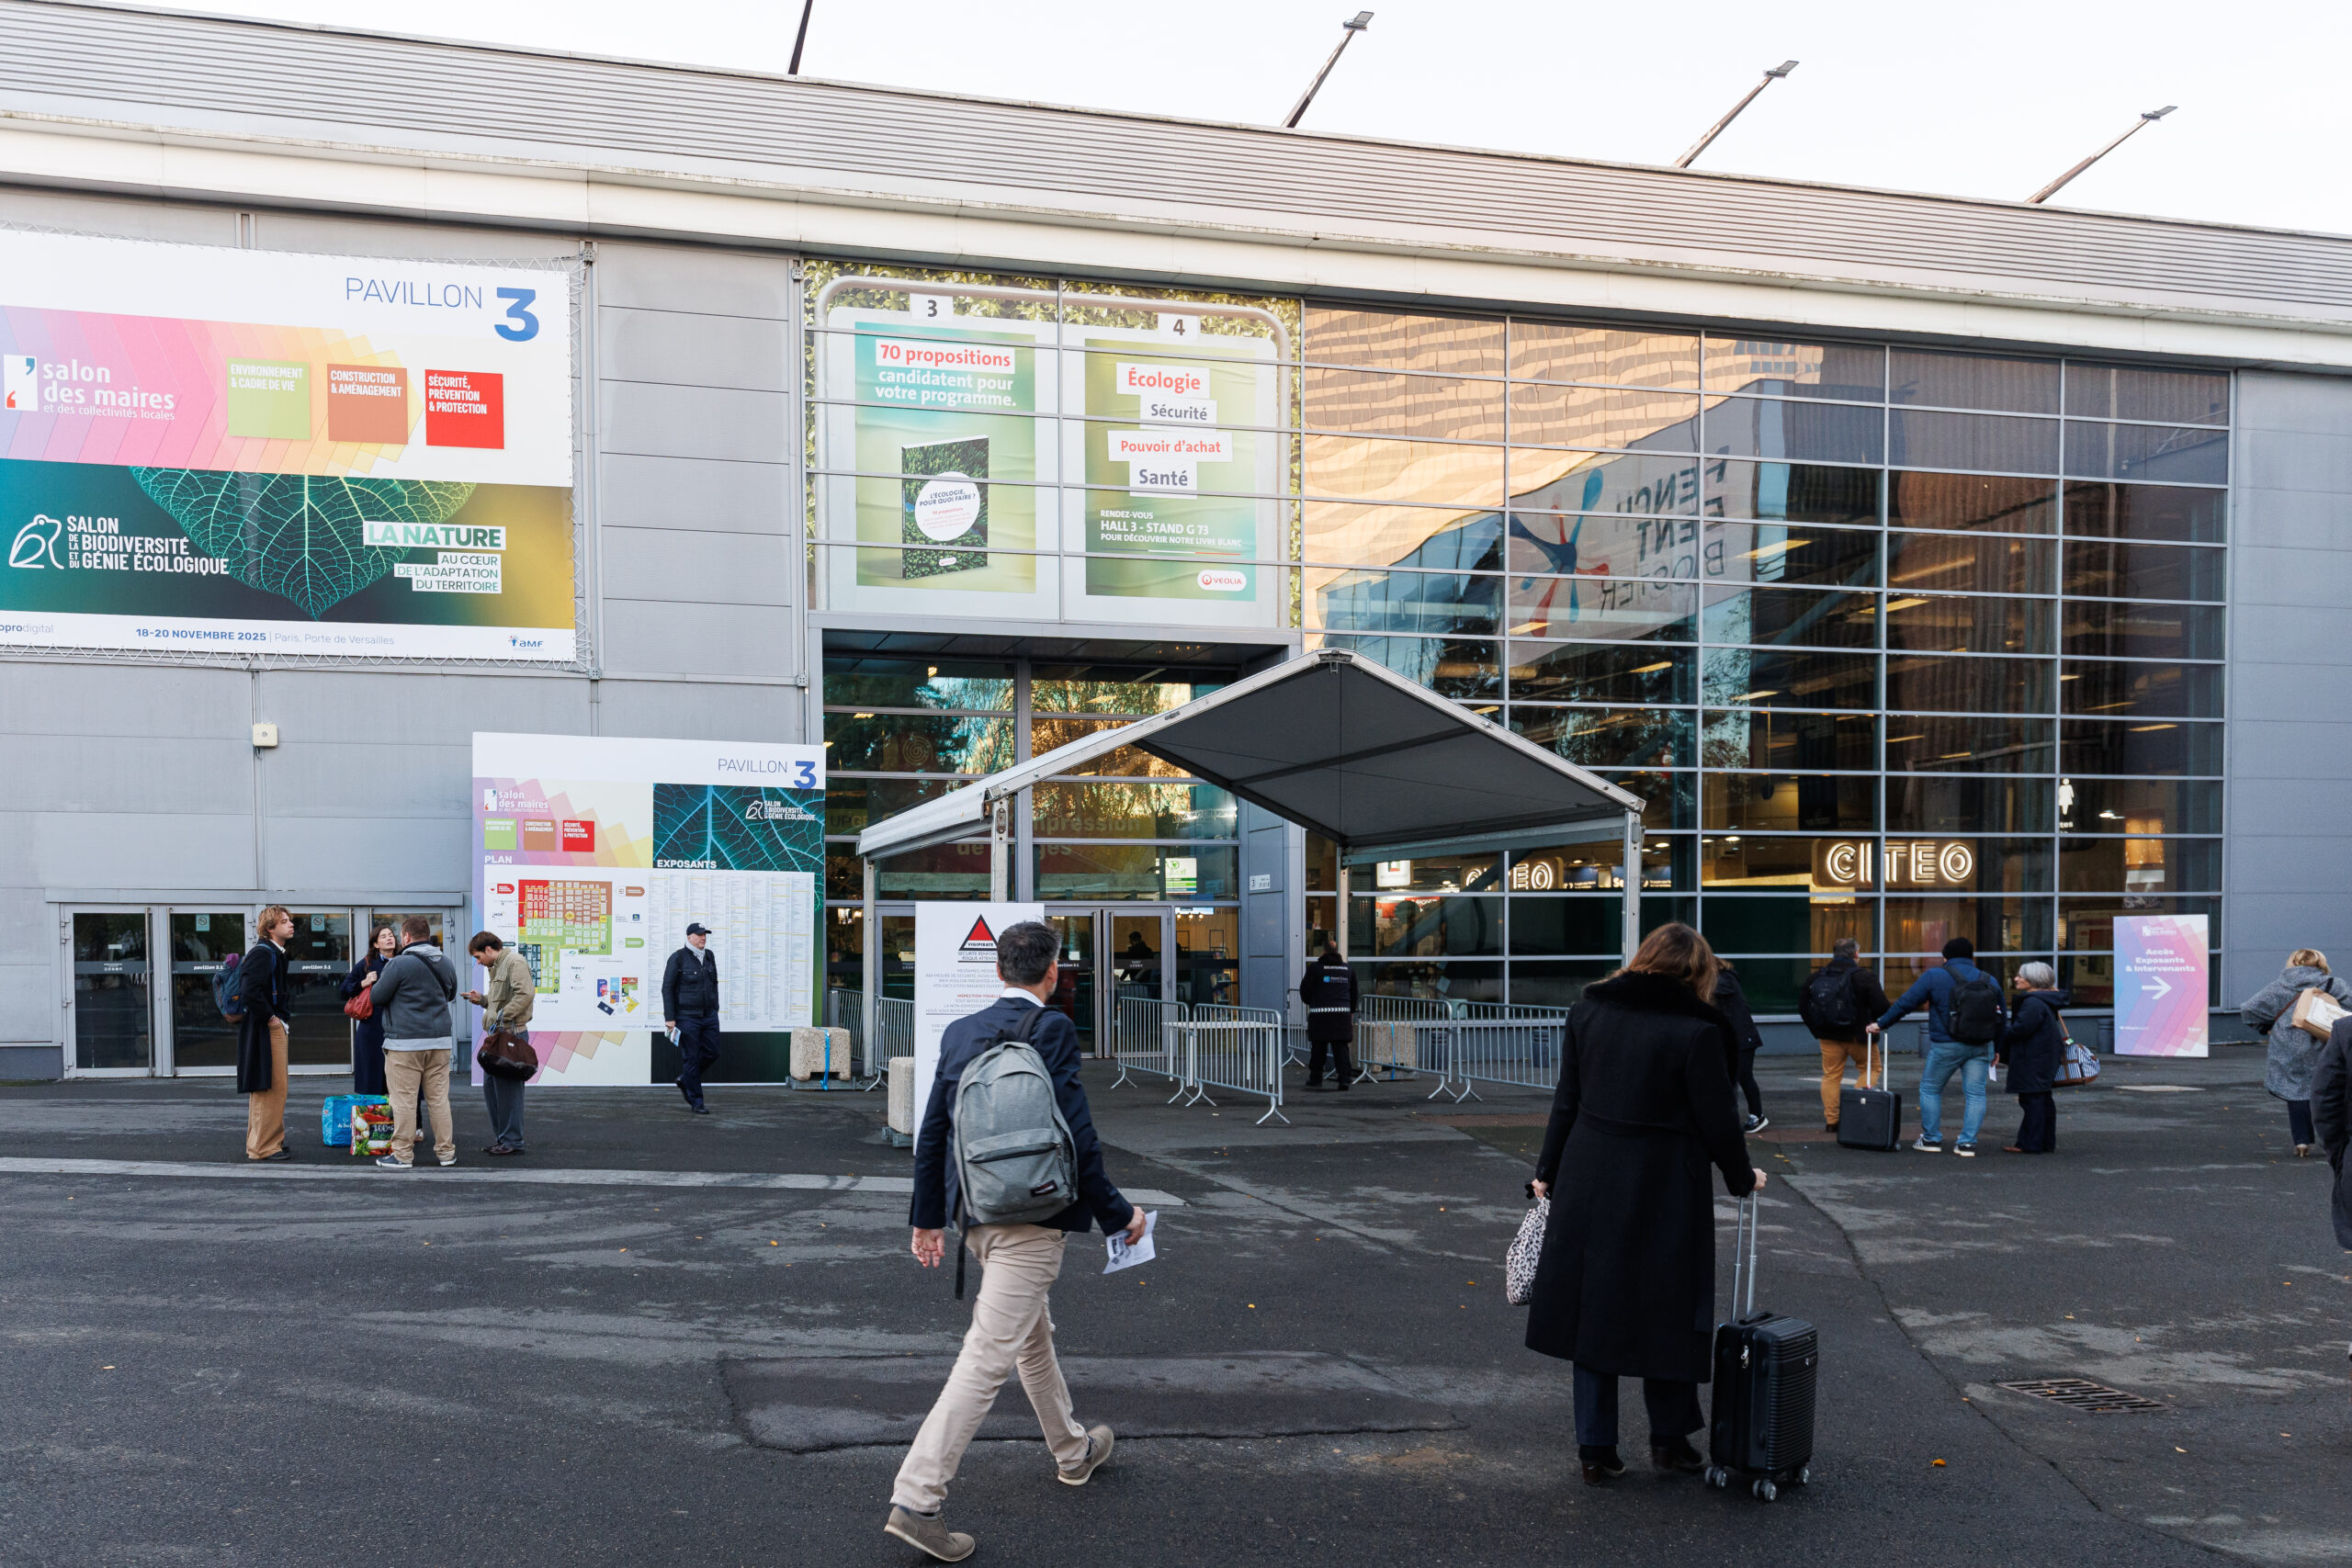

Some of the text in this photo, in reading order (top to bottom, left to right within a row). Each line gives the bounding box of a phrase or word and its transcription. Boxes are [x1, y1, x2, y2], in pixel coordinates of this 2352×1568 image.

[346, 277, 539, 342] PAVILLON 3
[927, 299, 938, 318] 3
[1172, 319, 1185, 335] 4
[880, 344, 1011, 367] 70 propositions
[43, 359, 110, 383] salon
[231, 363, 303, 378] ENVIRONNEMENT
[331, 369, 395, 384] CONSTRUCTION
[231, 378, 295, 391] & CADRE DE VIE
[428, 374, 470, 389] SÉCURITÉ,
[878, 370, 1013, 392] candidatent pour
[1128, 367, 1201, 394] Écologie
[43, 380, 175, 410] des maires
[331, 382, 401, 397] & AMÉNAGEMENT
[428, 386, 480, 401] PRÉVENTION
[875, 385, 1016, 407] votre programme.
[43, 404, 175, 421] et des collectivités locales
[428, 401, 487, 414] & PROTECTION
[1151, 403, 1207, 421] Sécurité
[1121, 440, 1221, 453] Pouvoir d'achat
[1139, 468, 1188, 487] Santé
[938, 496, 954, 504] QUOI
[1100, 510, 1154, 519] RENDEZ-VOUS
[67, 515, 119, 534] SALON
[1101, 521, 1128, 531] HALL
[1131, 522, 1136, 532] 3
[1147, 523, 1184, 535] STAND
[1186, 525, 1194, 535] G
[1197, 525, 1209, 535] 73
[368, 524, 502, 547] LA NATURE
[1124, 533, 1168, 544] DÉCOUVRIR
[1169, 536, 1194, 545] NOTRE
[1195, 537, 1216, 546] LIVRE
[1217, 538, 1242, 547] BLANC
[69, 534, 189, 556] DE LA BIODIVERSITÉ
[69, 551, 230, 576] ET DU GÉNIE ÉCOLOGIQUE
[441, 555, 458, 565] AU
[398, 566, 498, 579] DE L'ADAPTATION
[416, 580, 499, 592] DU TERRITOIRE
[136, 628, 266, 641] 18-20 NOVEMBRE 2025
[275, 633, 395, 645] Paris, Porte de Versailles
[718, 758, 817, 789] PAVILLON 3
[498, 790, 525, 799] salon
[499, 798, 549, 809] des maires
[484, 855, 513, 863] PLAN
[657, 859, 717, 869] EXPOSANTS
[1826, 842, 1973, 883] CITEO
